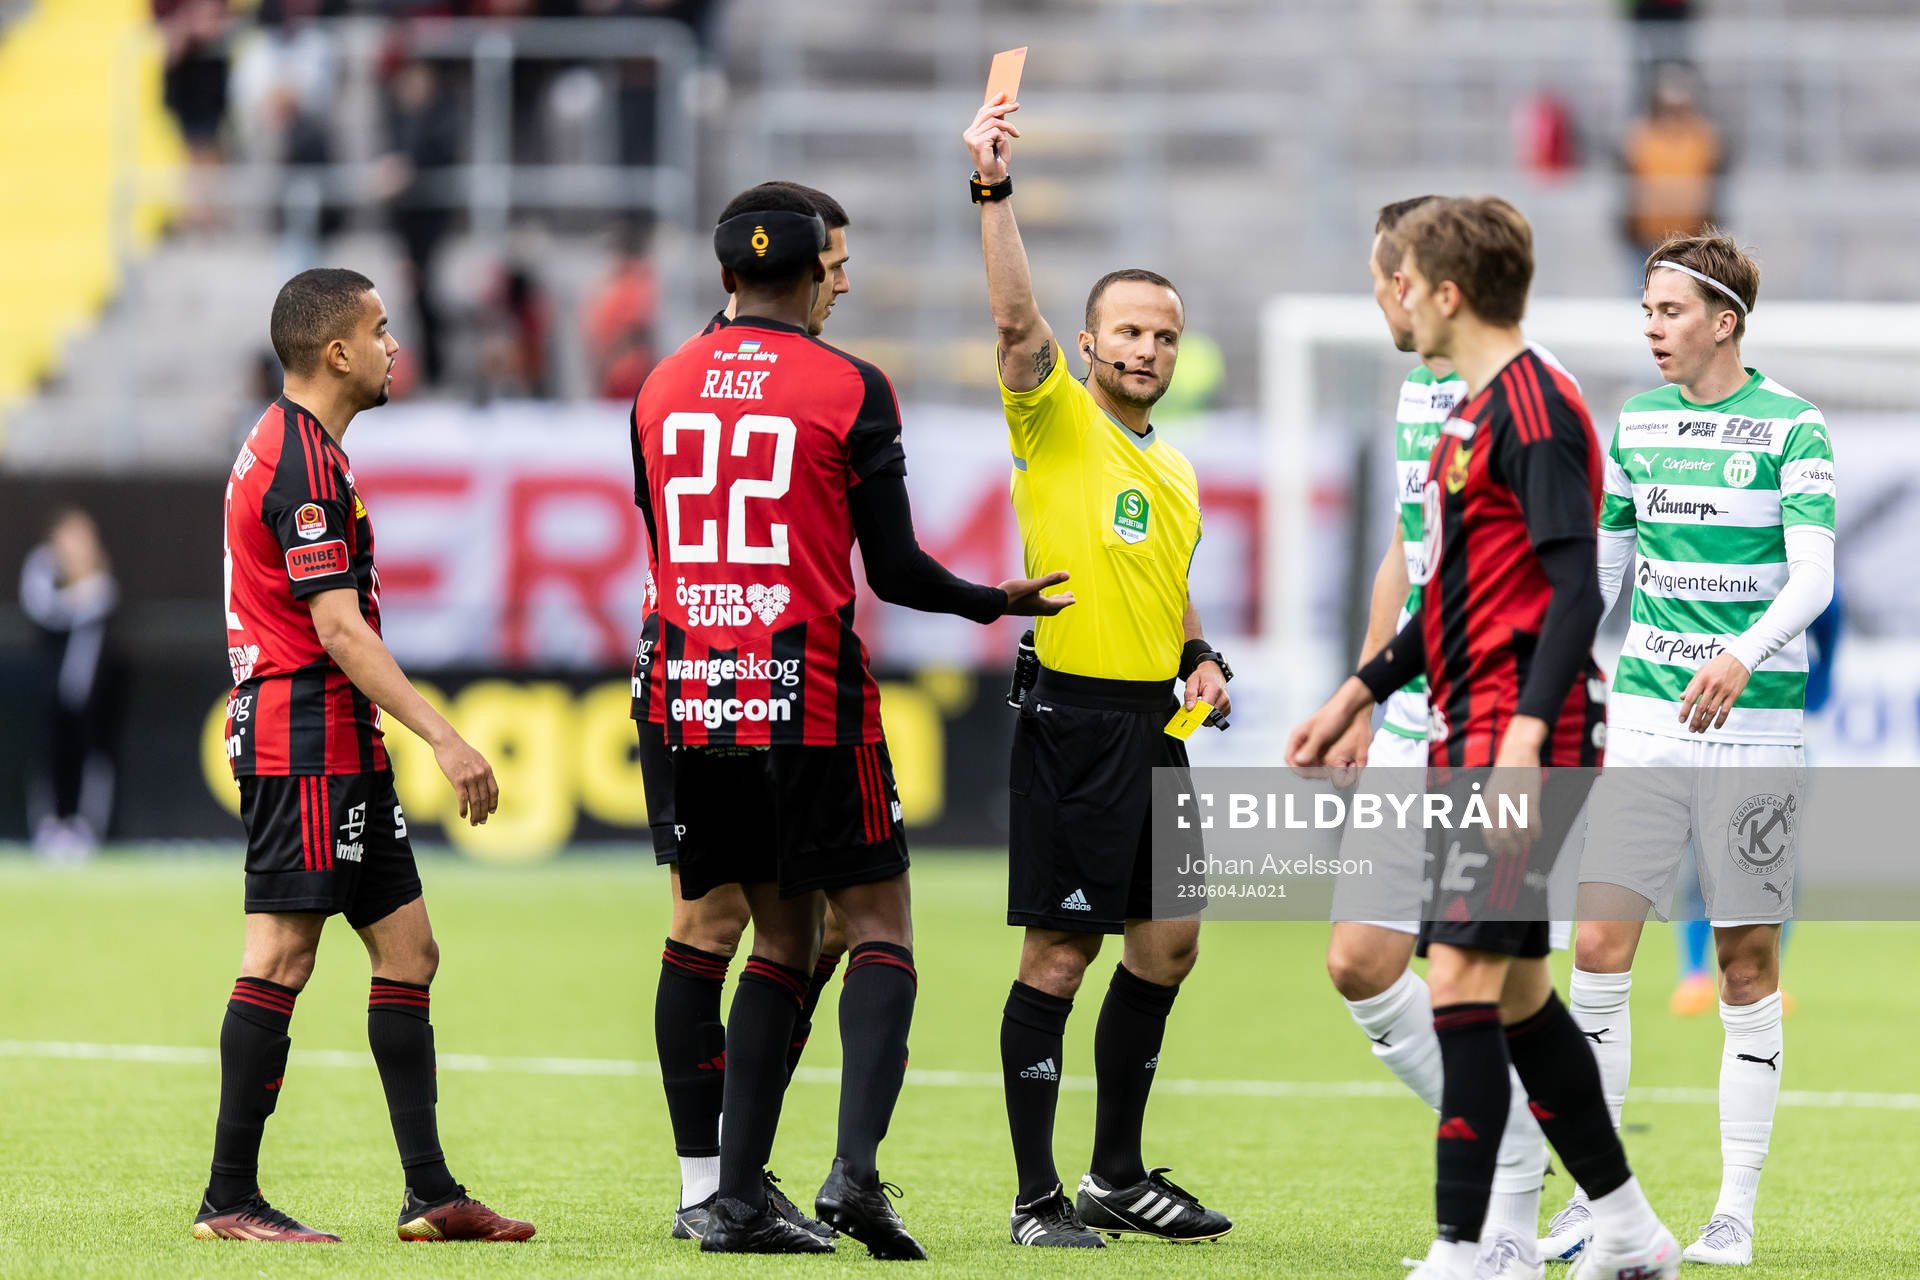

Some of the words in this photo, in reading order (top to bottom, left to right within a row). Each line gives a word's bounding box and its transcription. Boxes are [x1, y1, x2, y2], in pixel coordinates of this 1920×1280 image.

[700, 369, 770, 400] RASK
[1691, 429, 1715, 438] SPORT
[1692, 421, 1717, 430] INTER
[1723, 418, 1773, 438] SPOL
[1662, 457, 1715, 473] Carpenter
[663, 412, 797, 566] 22
[1646, 486, 1726, 520] Kinnarps
[292, 547, 343, 566] UNIBET
[676, 576, 744, 606] ÖSTER
[688, 605, 752, 627] SUND
[1646, 631, 1726, 661] Carpent
[667, 653, 799, 686] wangeskog
[1061, 901, 1092, 911] adidas
[1020, 1069, 1058, 1081] adidas
